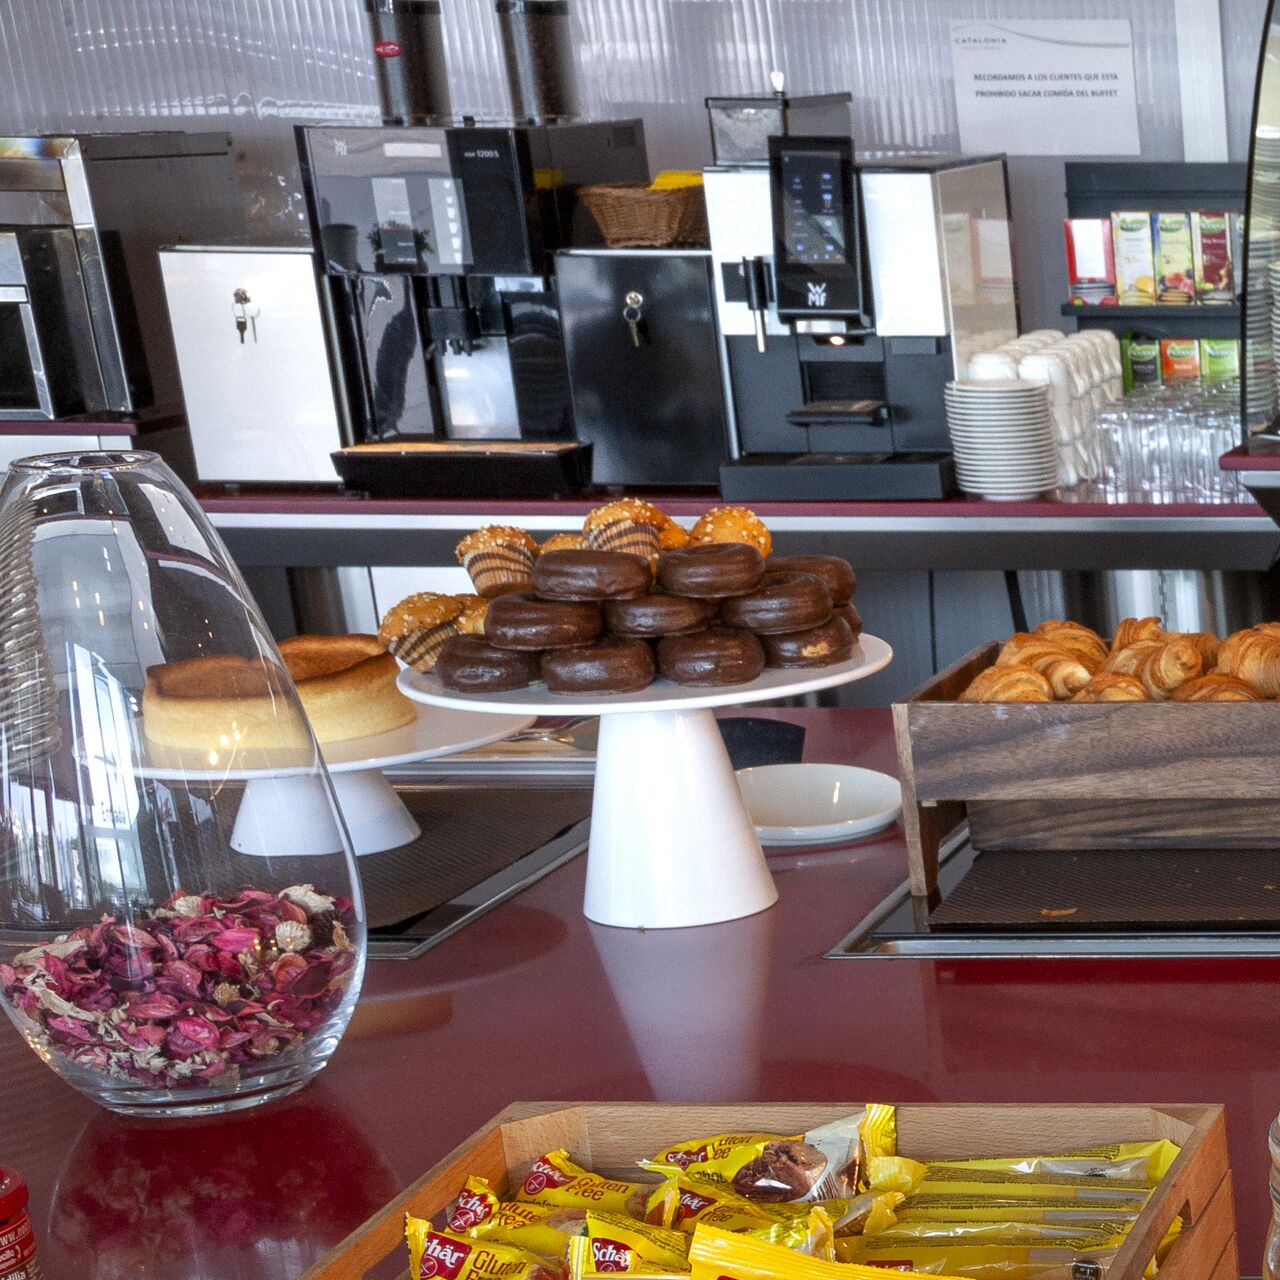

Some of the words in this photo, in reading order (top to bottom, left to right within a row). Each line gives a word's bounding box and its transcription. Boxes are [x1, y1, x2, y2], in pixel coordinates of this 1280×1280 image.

[973, 73, 1026, 82] RECORDAMOS
[1027, 73, 1033, 81] A
[1034, 73, 1048, 81] LOS
[1050, 73, 1083, 81] CLIENTES
[1084, 73, 1099, 82] QUE
[1101, 73, 1118, 81] ESTA
[975, 90, 1017, 98] PROHIBIDO
[1018, 90, 1042, 98] SACAR
[1043, 90, 1074, 98] COMIDA
[1076, 90, 1089, 98] DEL
[1091, 90, 1118, 98] BUFFET
[531, 1161, 570, 1182] chär
[499, 1202, 542, 1223] Glute
[472, 1249, 528, 1277] Gluten
